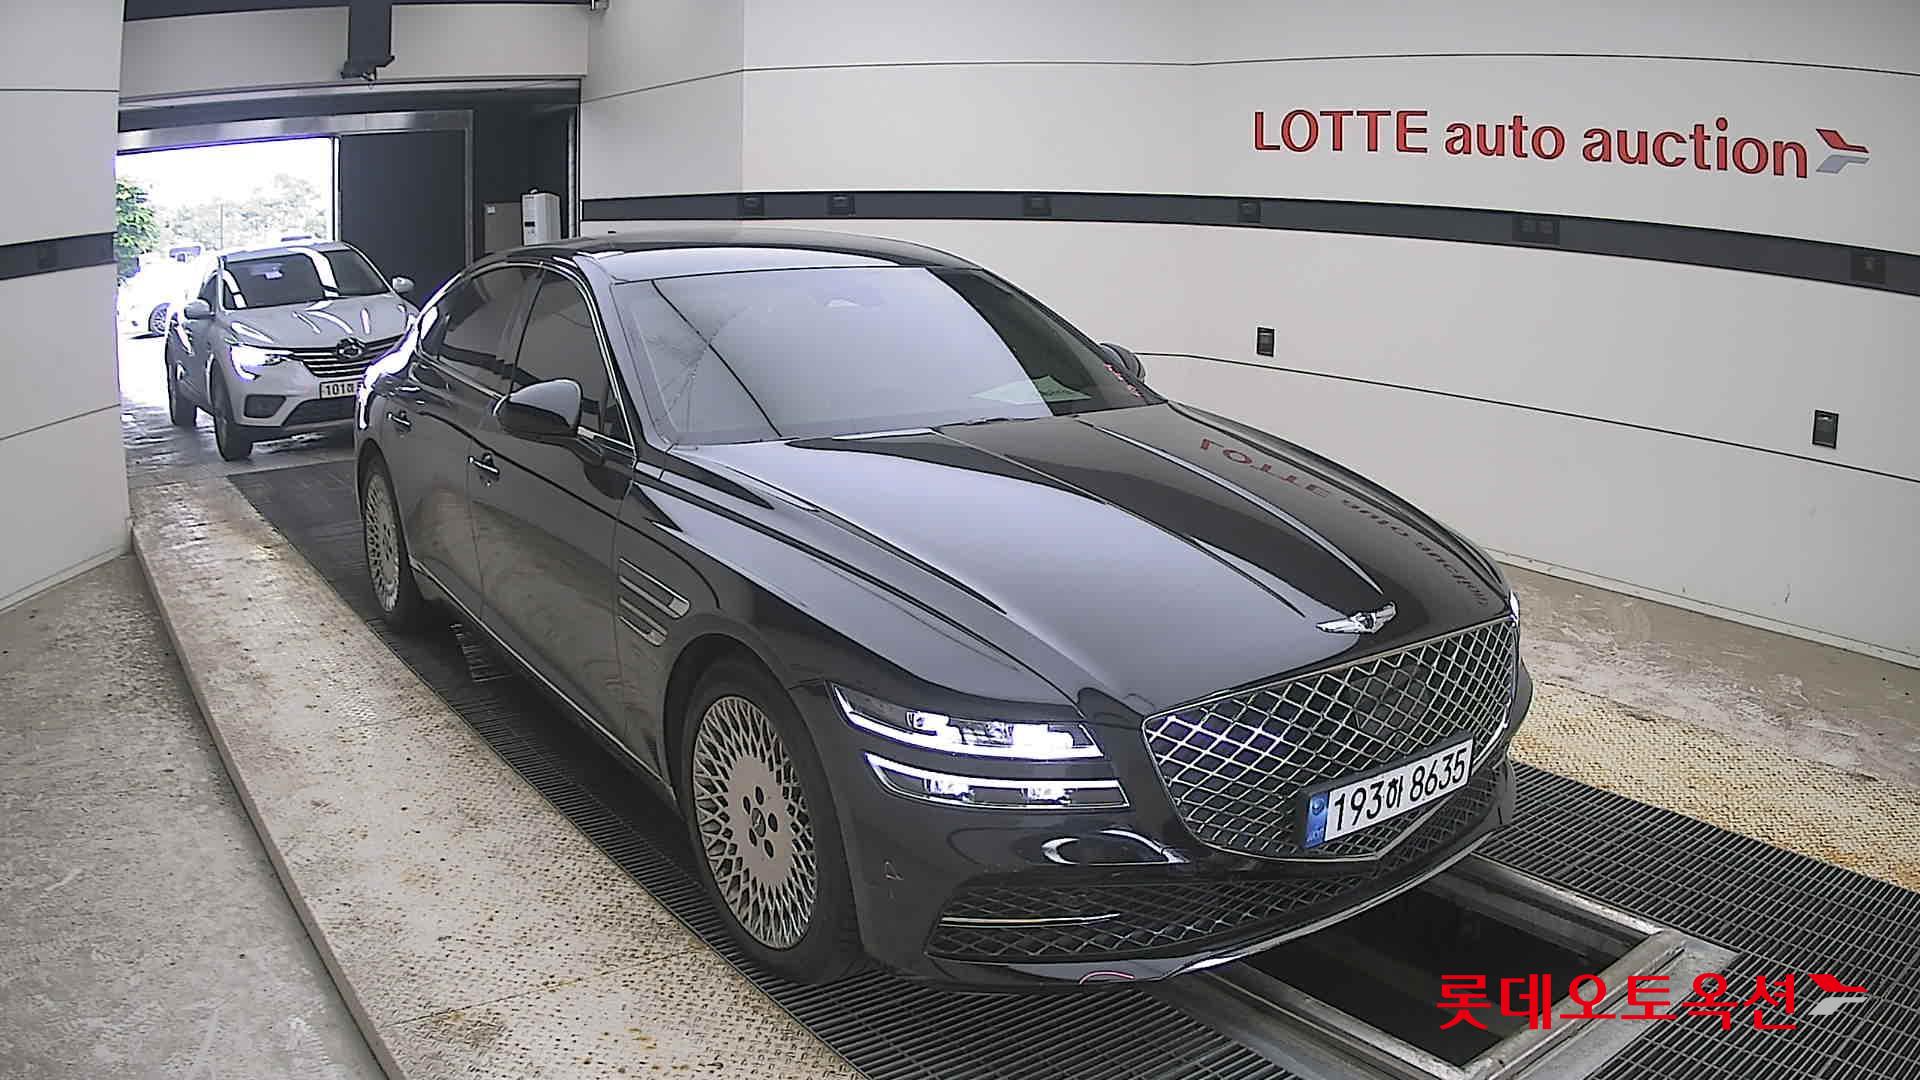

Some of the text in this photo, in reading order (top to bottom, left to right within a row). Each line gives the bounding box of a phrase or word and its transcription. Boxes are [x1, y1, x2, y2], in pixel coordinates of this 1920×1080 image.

[1254, 109, 1808, 179] LOTTE auto auction
[1334, 747, 1468, 831] 193하 8635
